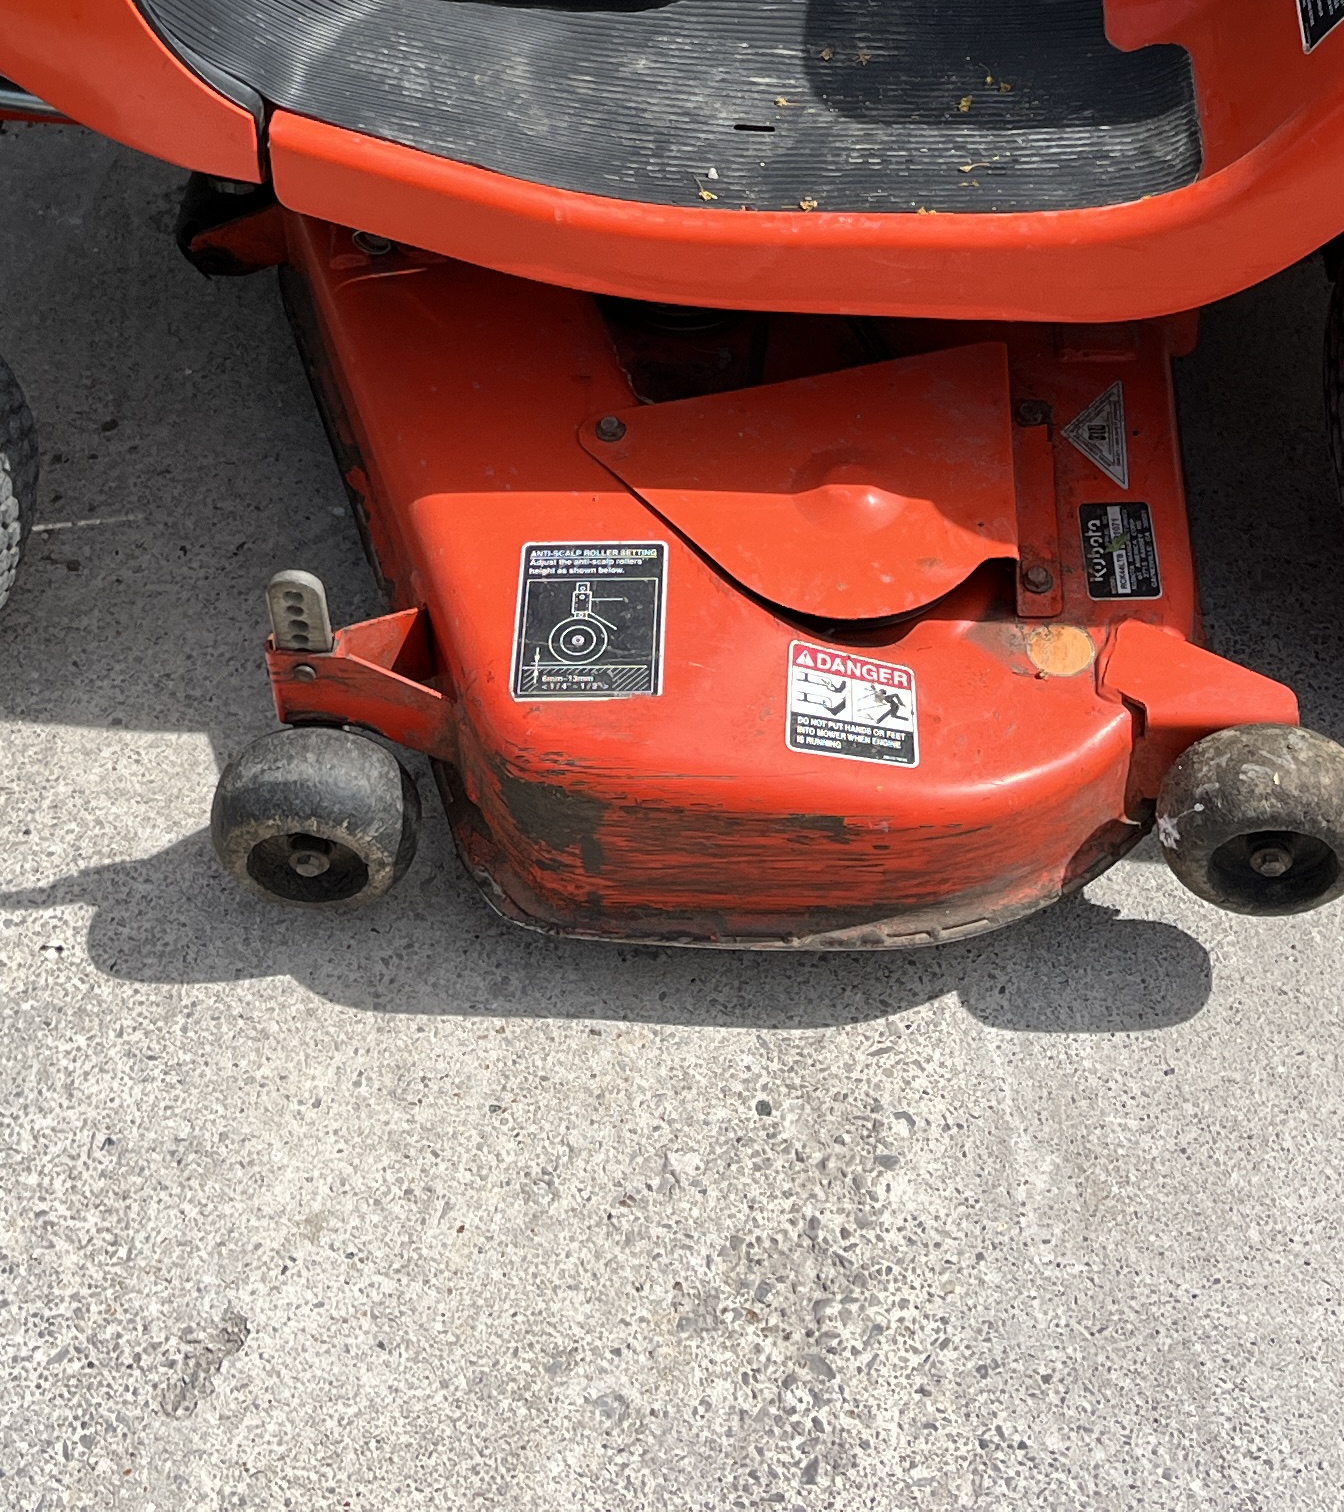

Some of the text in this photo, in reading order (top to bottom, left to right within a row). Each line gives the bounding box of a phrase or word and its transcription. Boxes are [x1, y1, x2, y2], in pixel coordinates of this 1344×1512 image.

[530, 548, 658, 557] ANTI-SCALP ROLLER SETTING
[1085, 519, 1108, 582] Kubota
[528, 567, 556, 576] height
[597, 566, 625, 574] below.
[529, 558, 557, 567] Adjust
[558, 558, 573, 566] the
[573, 558, 614, 567] anti-scalp
[816, 652, 908, 687] DANGER
[796, 725, 902, 749] INTO MOWER WHEN ENGINE
[797, 716, 906, 741] DO NOT PUT HANDS OR FEET
[796, 734, 842, 749] IS RUNNING
